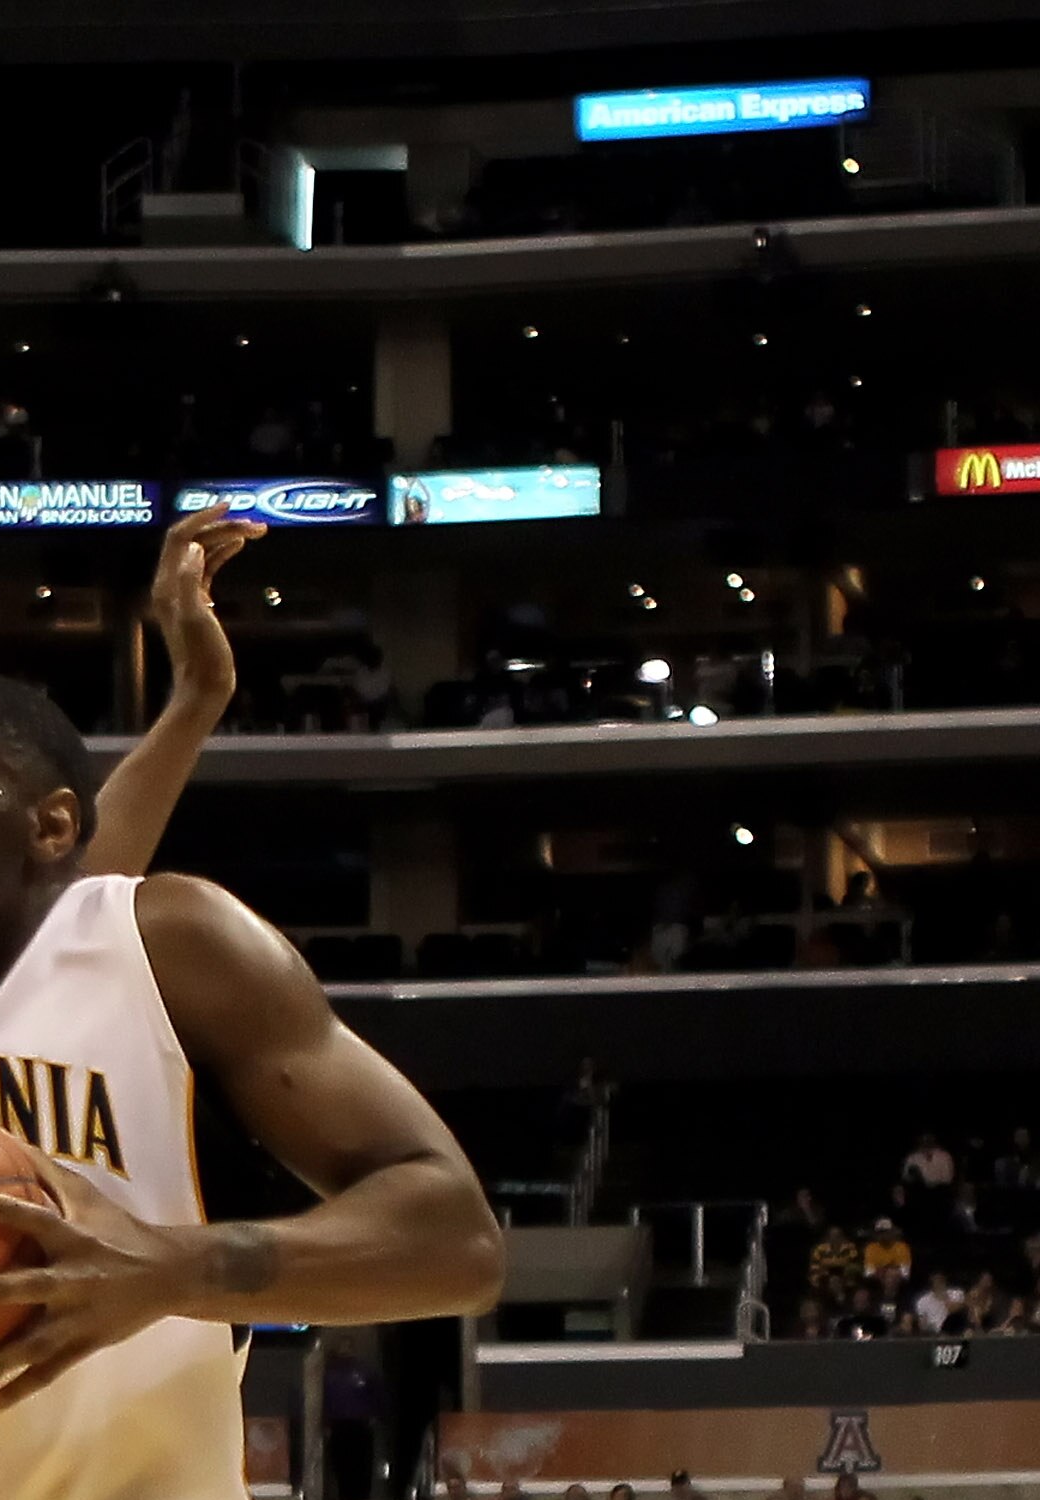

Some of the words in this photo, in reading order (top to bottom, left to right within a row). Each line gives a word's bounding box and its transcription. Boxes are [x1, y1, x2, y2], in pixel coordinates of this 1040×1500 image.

[587, 99, 736, 129] American
[740, 92, 865, 123] Express
[1005, 458, 1040, 479] Mc
[42, 484, 152, 508] MANUEL
[180, 492, 257, 511] BUD
[274, 492, 377, 511] LIGHT
